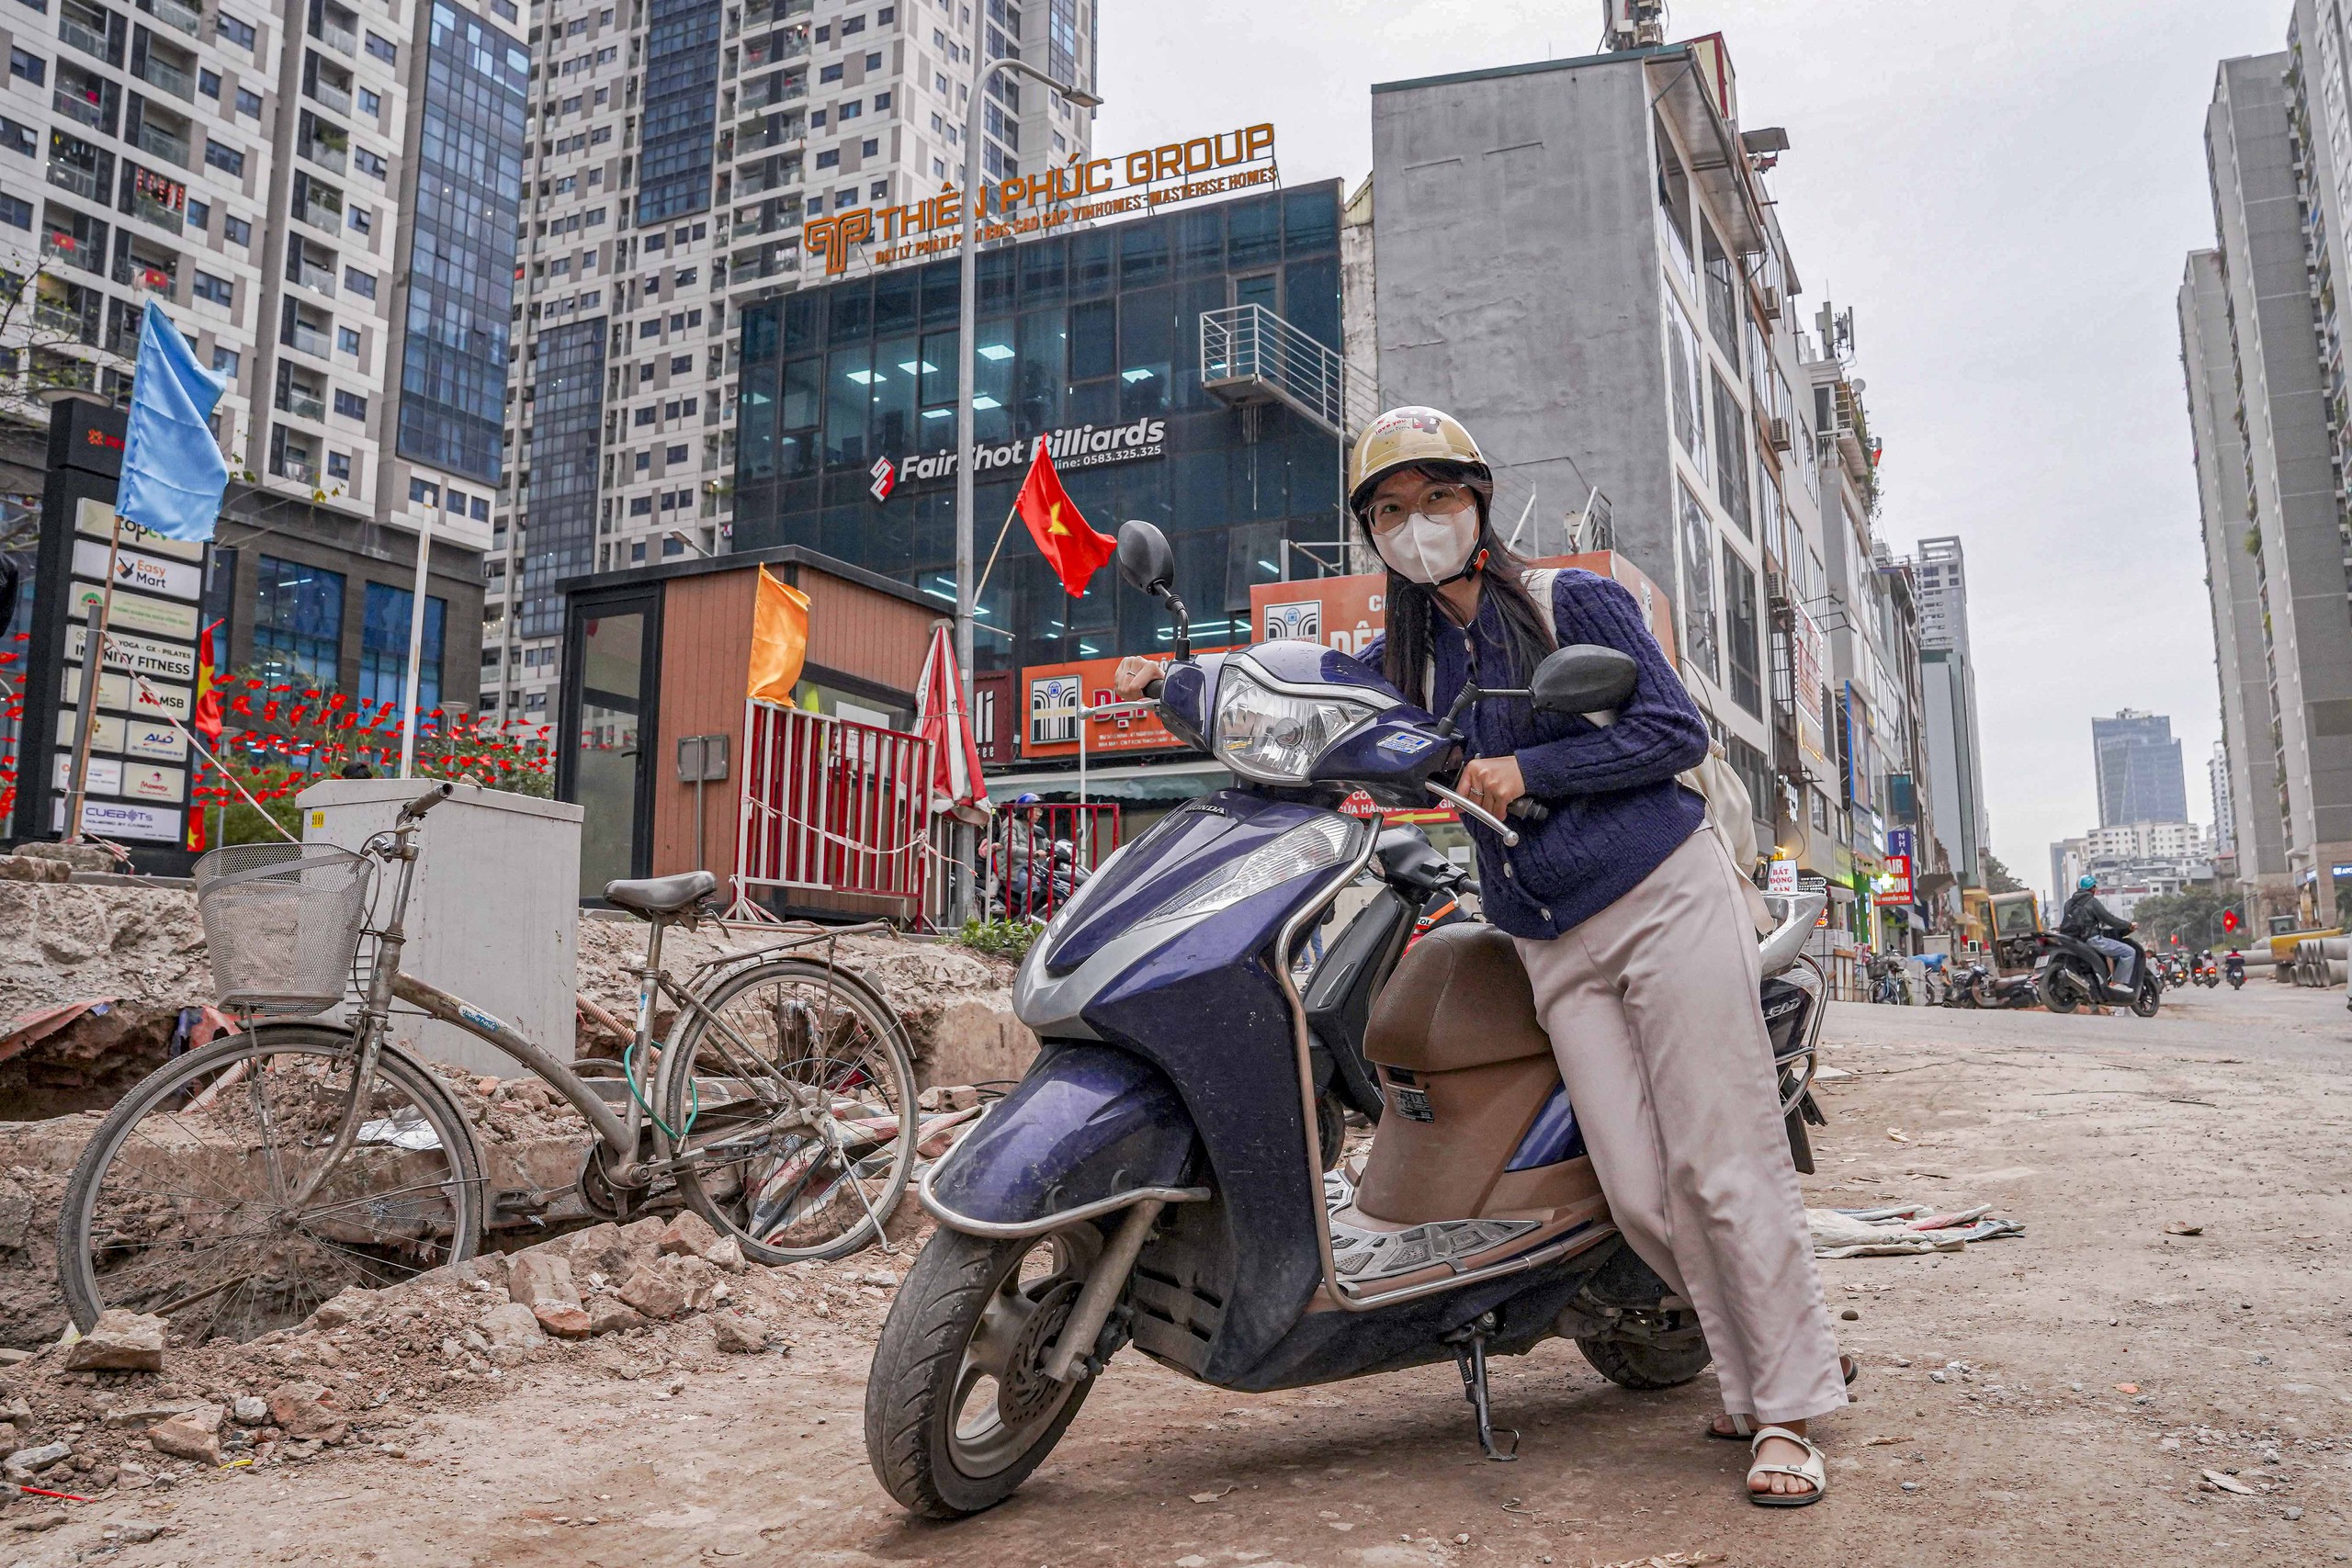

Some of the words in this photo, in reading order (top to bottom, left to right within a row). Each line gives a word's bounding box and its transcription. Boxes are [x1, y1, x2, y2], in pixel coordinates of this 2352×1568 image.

[876, 181, 987, 241] THIÊN
[1000, 152, 1113, 214] PHÚC
[1126, 123, 1275, 186] GROUP
[1228, 165, 1276, 190] HOMES
[899, 448, 958, 482] Fair
[1030, 417, 1166, 462] Billiards
[1083, 445, 1161, 466] 0583.325.325
[137, 559, 166, 578] Easy
[136, 572, 166, 588] Mart
[75, 644, 134, 665] INNITY
[138, 655, 191, 675] FITNESS
[119, 640, 140, 650] YOGA
[145, 645, 156, 653] GX
[162, 648, 192, 660] PILATES
[159, 695, 185, 708] MSB
